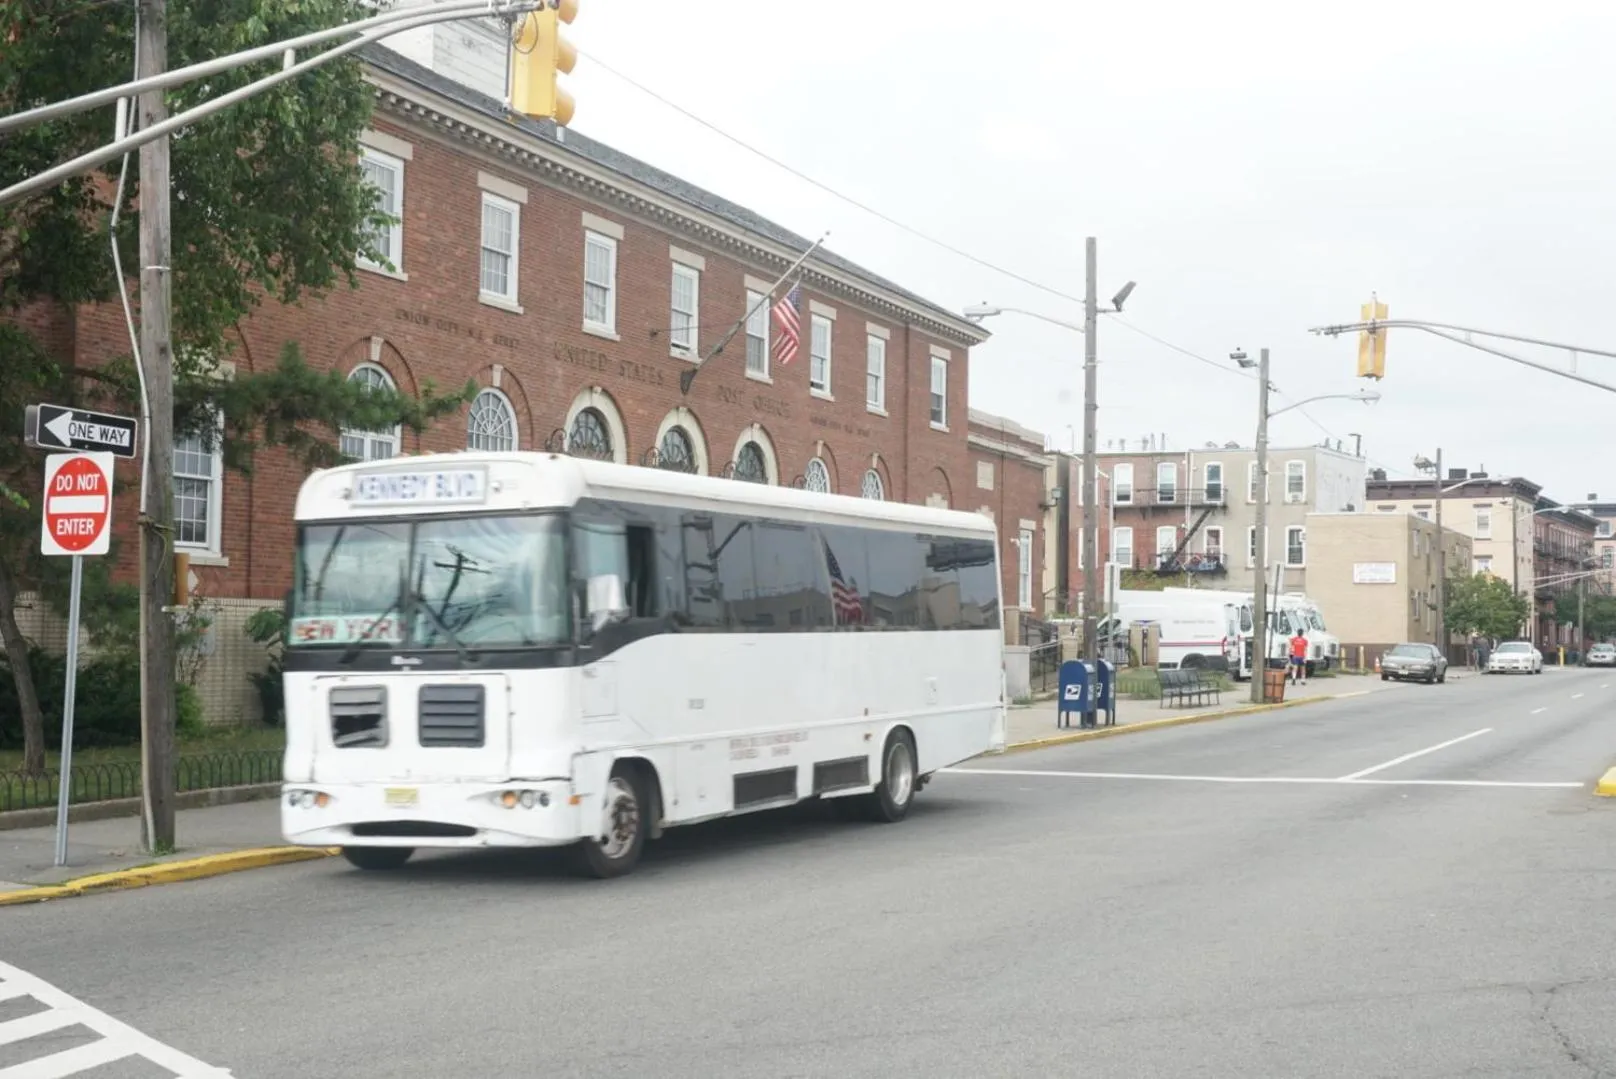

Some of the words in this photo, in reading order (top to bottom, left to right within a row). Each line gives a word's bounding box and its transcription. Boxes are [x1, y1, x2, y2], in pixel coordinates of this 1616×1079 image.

[554, 342, 607, 371] UNITED
[619, 360, 664, 385] STATES
[68, 423, 95, 440] ONE
[100, 428, 127, 444] WAY
[56, 475, 73, 491] DO
[77, 474, 100, 490] NOT
[56, 518, 95, 535] ENTER
